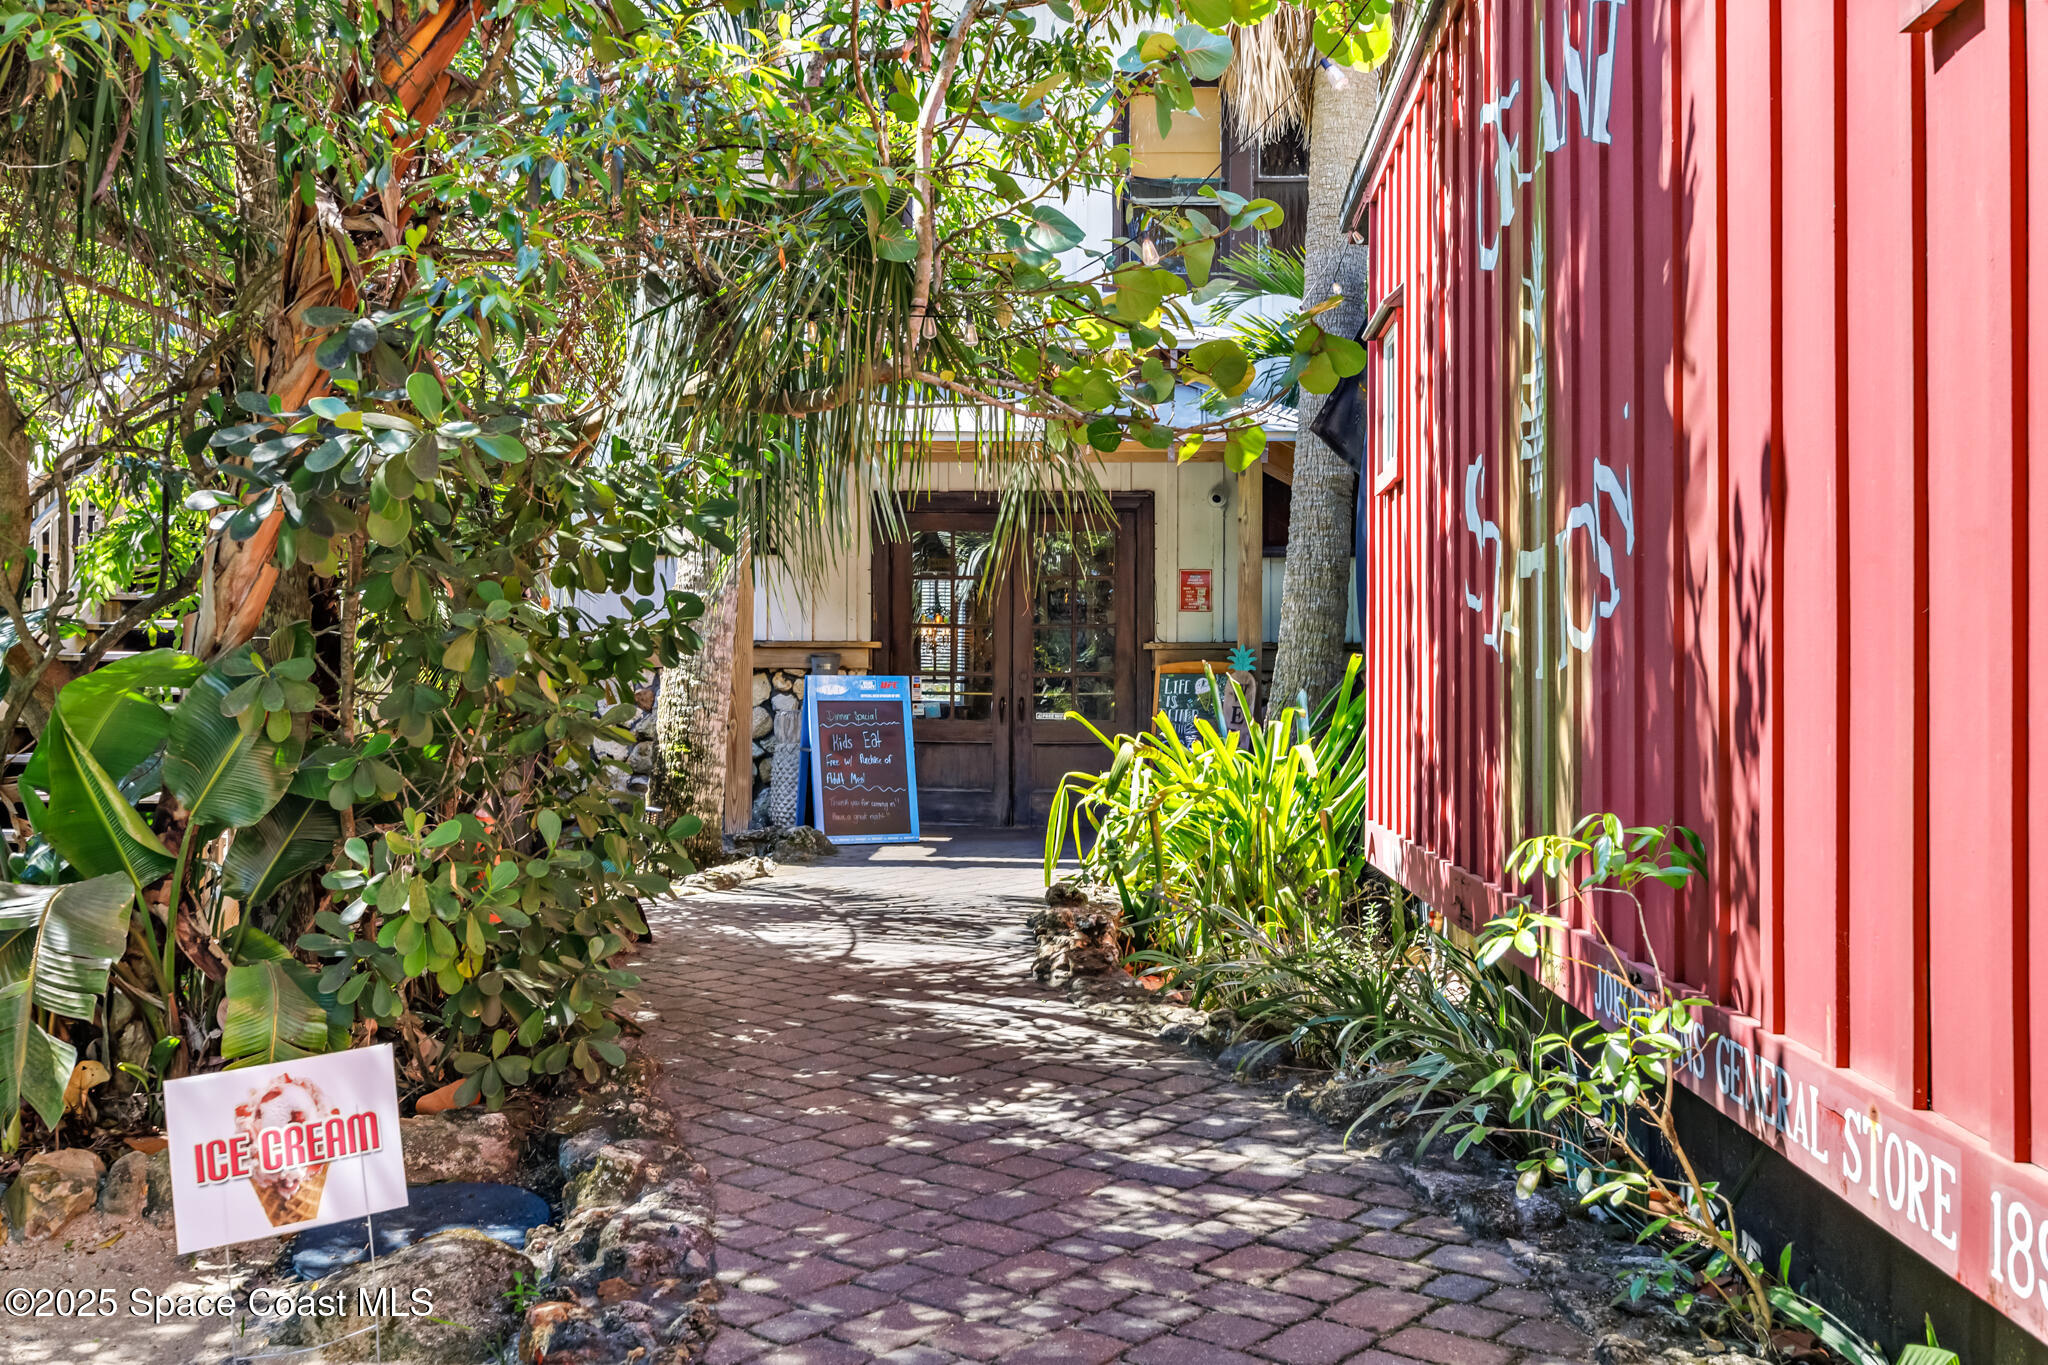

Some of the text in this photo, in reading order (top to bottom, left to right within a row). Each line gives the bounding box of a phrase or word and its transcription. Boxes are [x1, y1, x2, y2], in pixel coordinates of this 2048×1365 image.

[826, 753, 840, 767] Free
[843, 755, 853, 767] w/
[884, 754, 893, 765] of
[832, 730, 882, 751] Kids Eat
[194, 1111, 382, 1186] ICE CREAM
[1715, 1035, 1829, 1165] GENERAL
[1842, 1107, 1958, 1252] STORE
